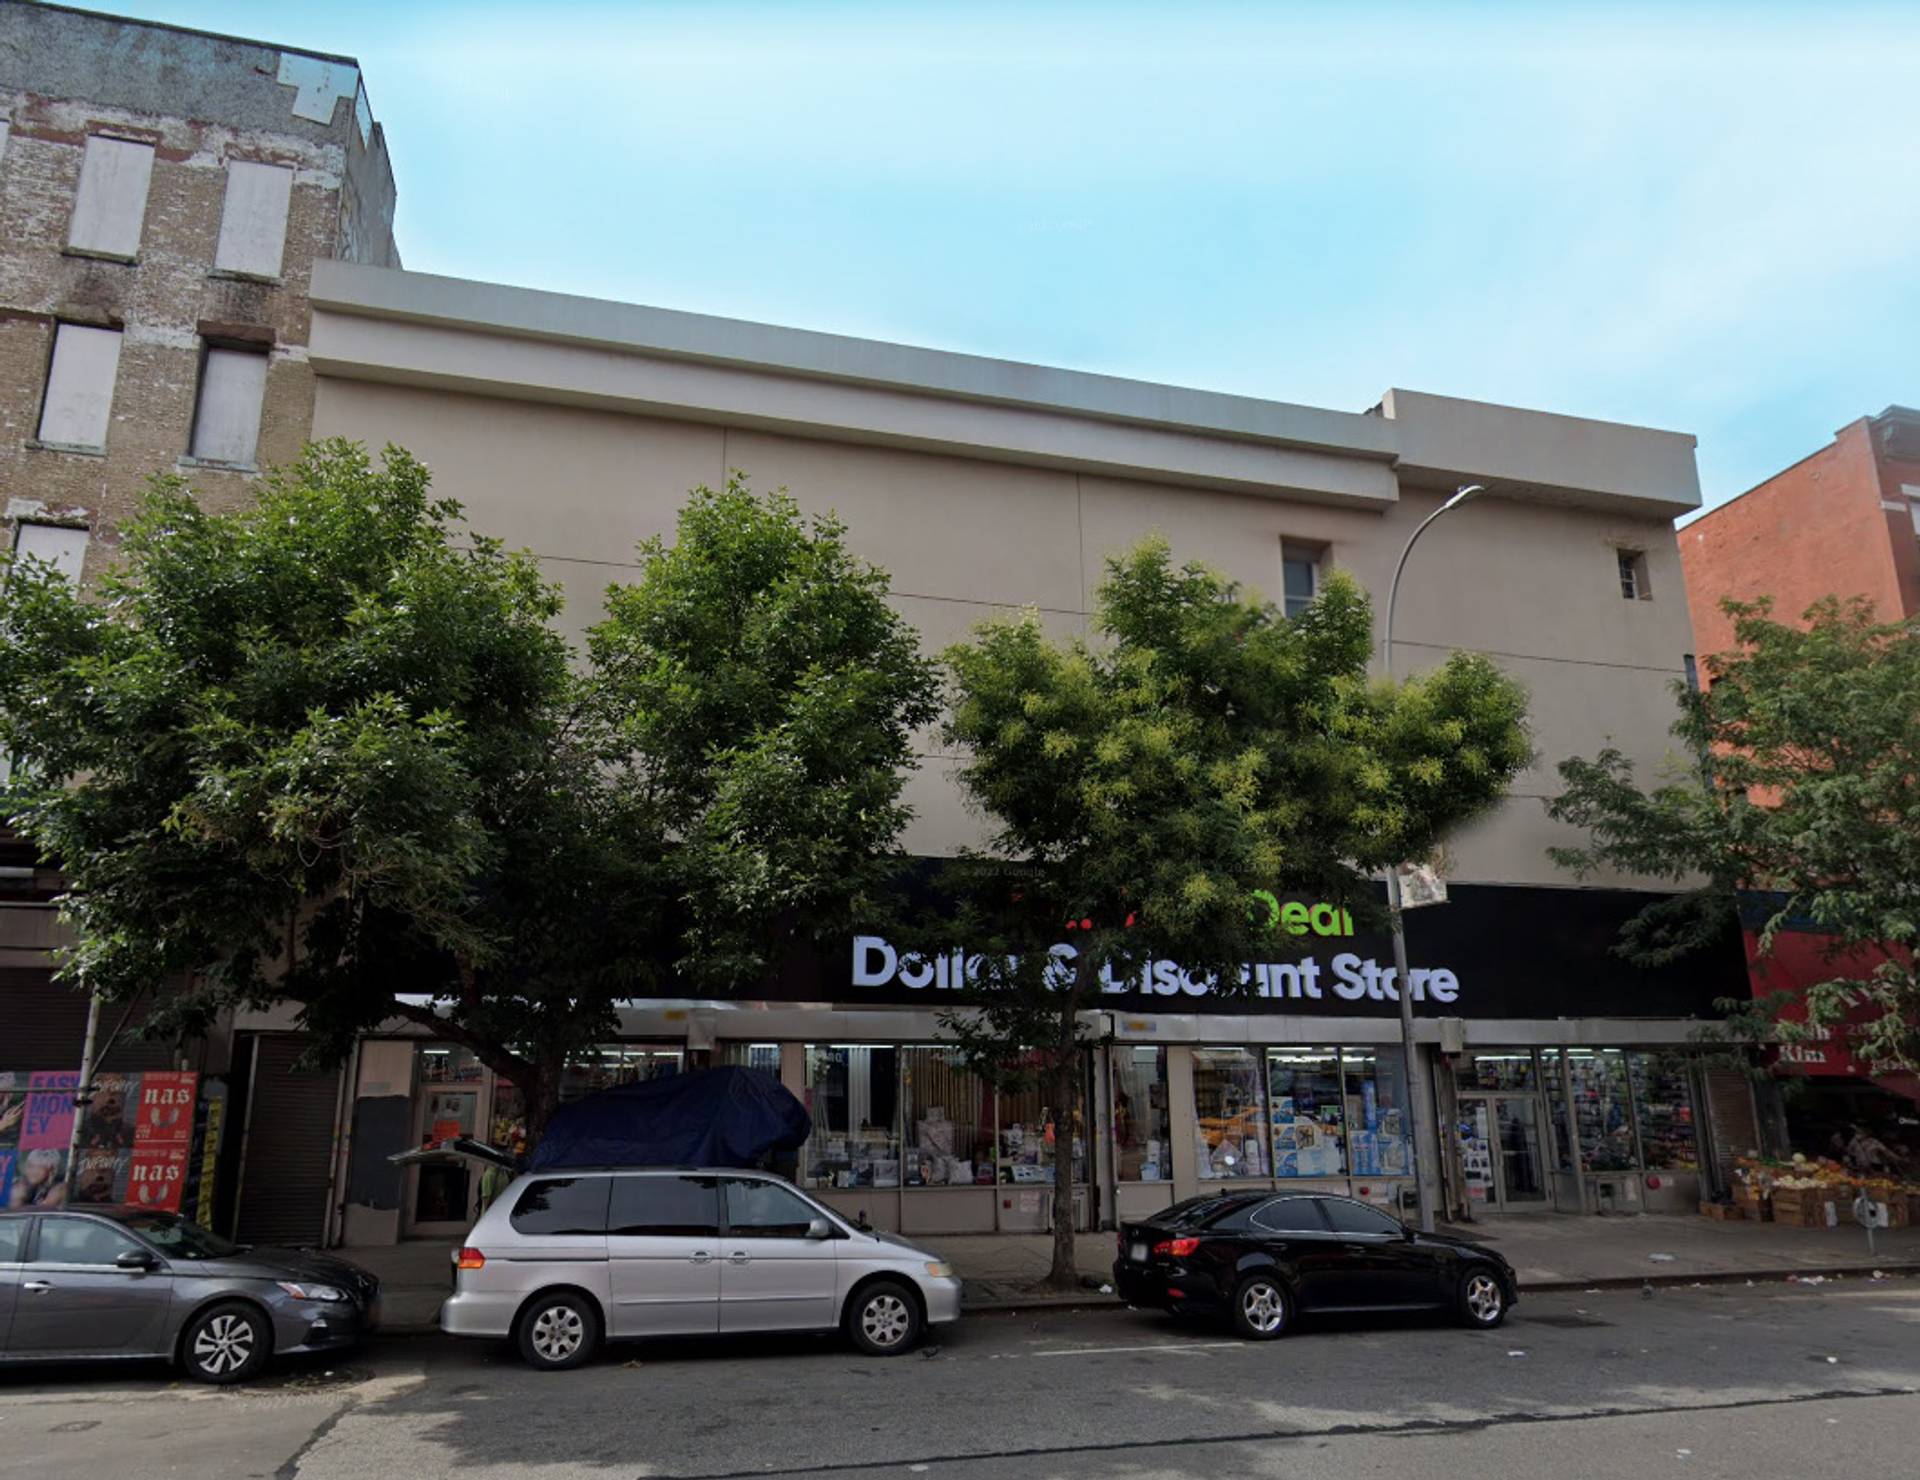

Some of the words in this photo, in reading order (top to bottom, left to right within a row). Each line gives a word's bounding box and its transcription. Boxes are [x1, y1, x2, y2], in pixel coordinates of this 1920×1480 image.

[1332, 953, 1459, 1003] Store
[144, 1088, 191, 1104] nas
[132, 1164, 180, 1182] nas
